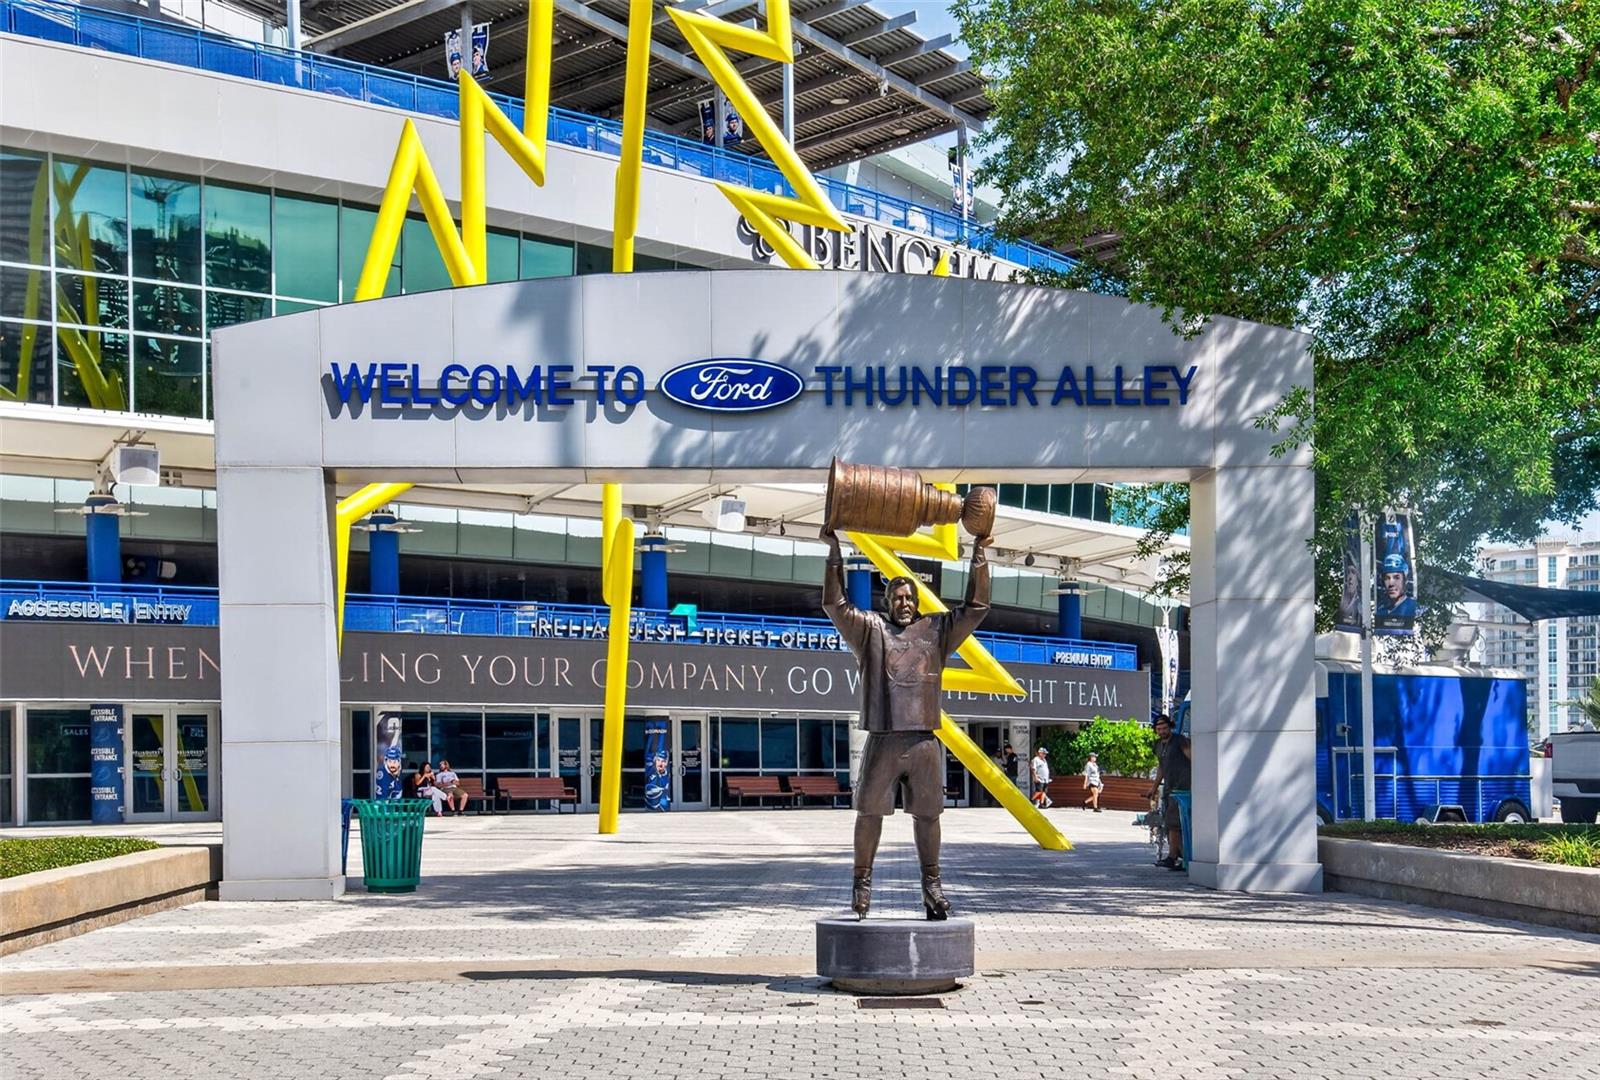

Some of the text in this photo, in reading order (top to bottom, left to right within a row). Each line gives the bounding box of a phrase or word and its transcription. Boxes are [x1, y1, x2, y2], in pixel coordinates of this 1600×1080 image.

[331, 362, 1199, 407] WELCOME TO Ford THUNDER ALLEY
[8, 599, 193, 621] ACCESSIBLE ENTRY
[538, 617, 849, 651] RELIAUEST TICKET OFFICE
[1055, 651, 1113, 666] PREMIUM ENTRY
[69, 645, 221, 681] WHEN
[461, 654, 574, 687] YOUR
[591, 657, 775, 695] COMPANY,
[787, 665, 834, 696] GO
[1064, 680, 1124, 708] TEAM.
[63, 728, 89, 736] SALES
